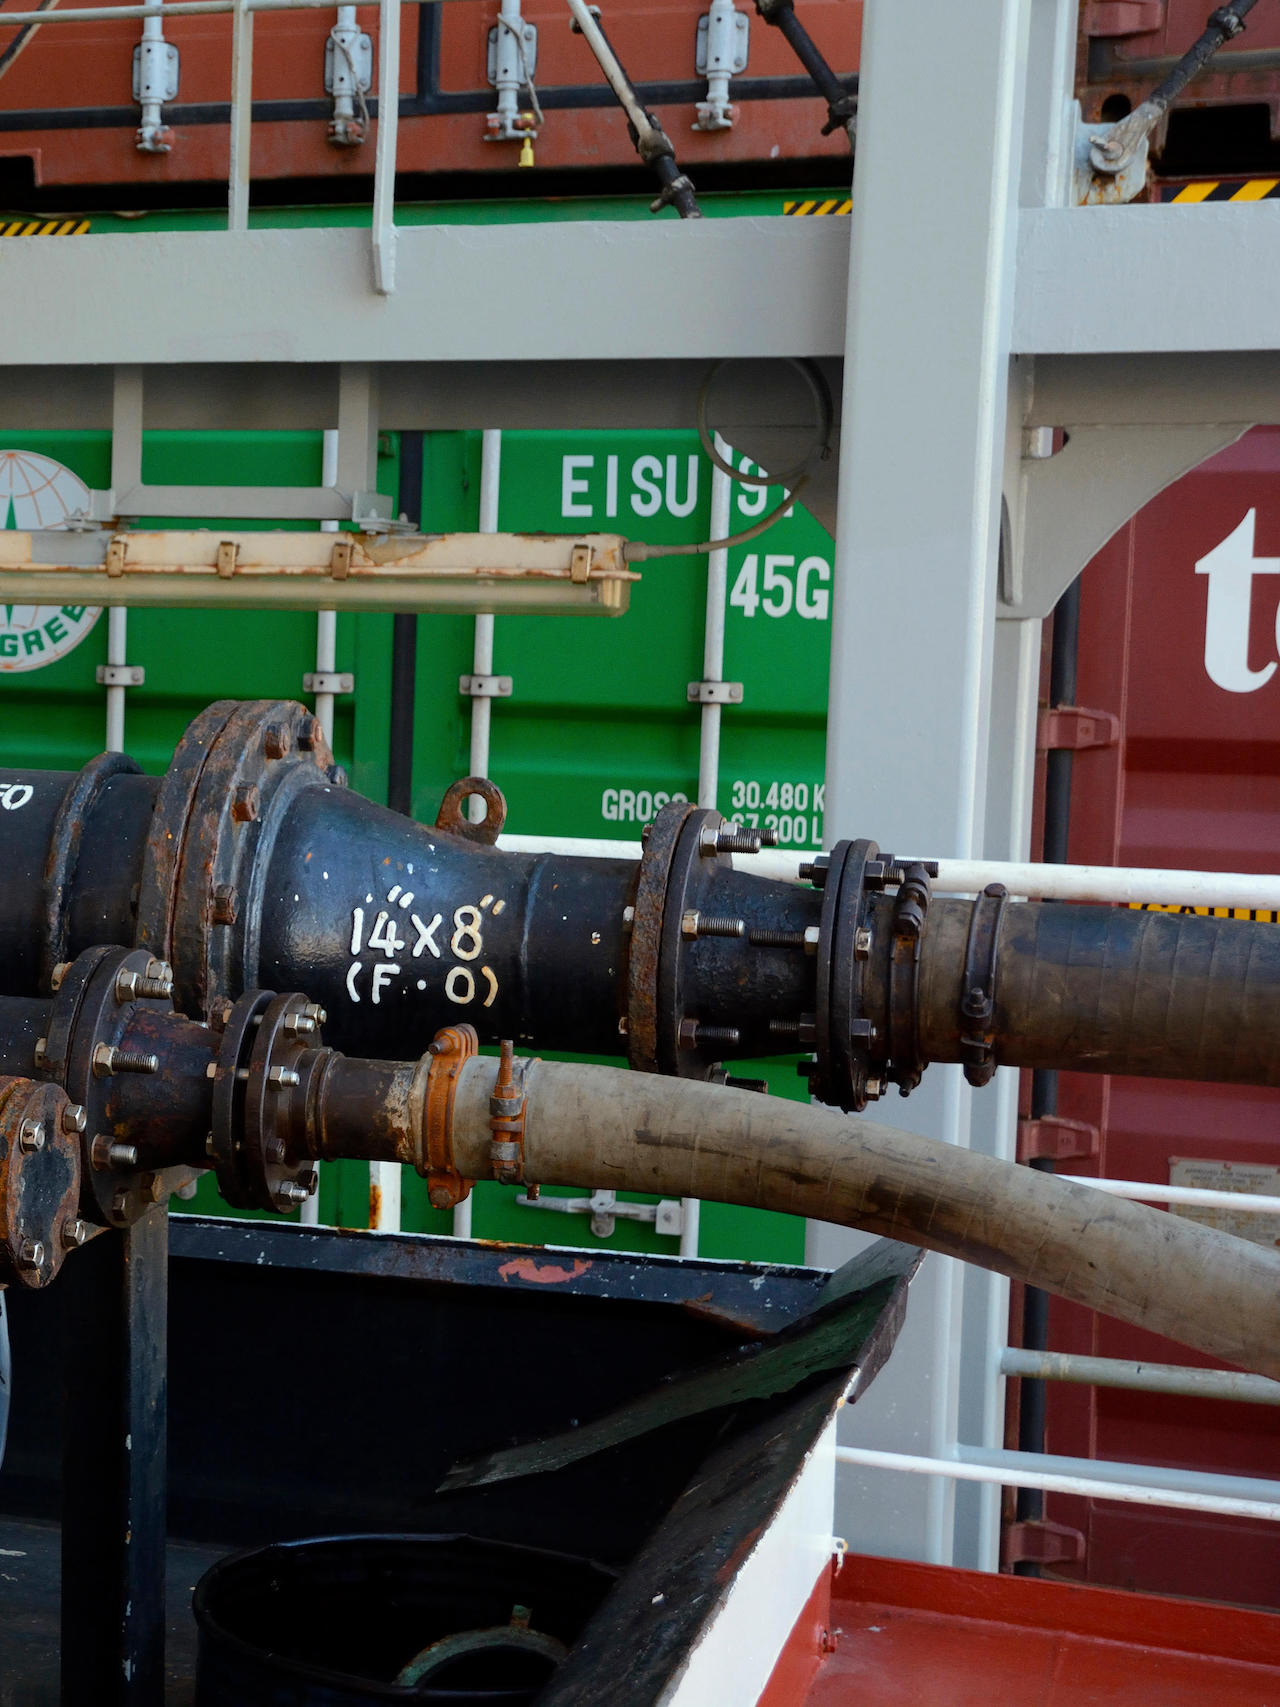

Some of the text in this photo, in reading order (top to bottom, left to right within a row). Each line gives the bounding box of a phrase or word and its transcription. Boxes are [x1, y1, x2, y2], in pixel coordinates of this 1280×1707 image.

[561, 455, 699, 518] EISU
[1194, 507, 1280, 693] t
[731, 780, 809, 812] 30.480
